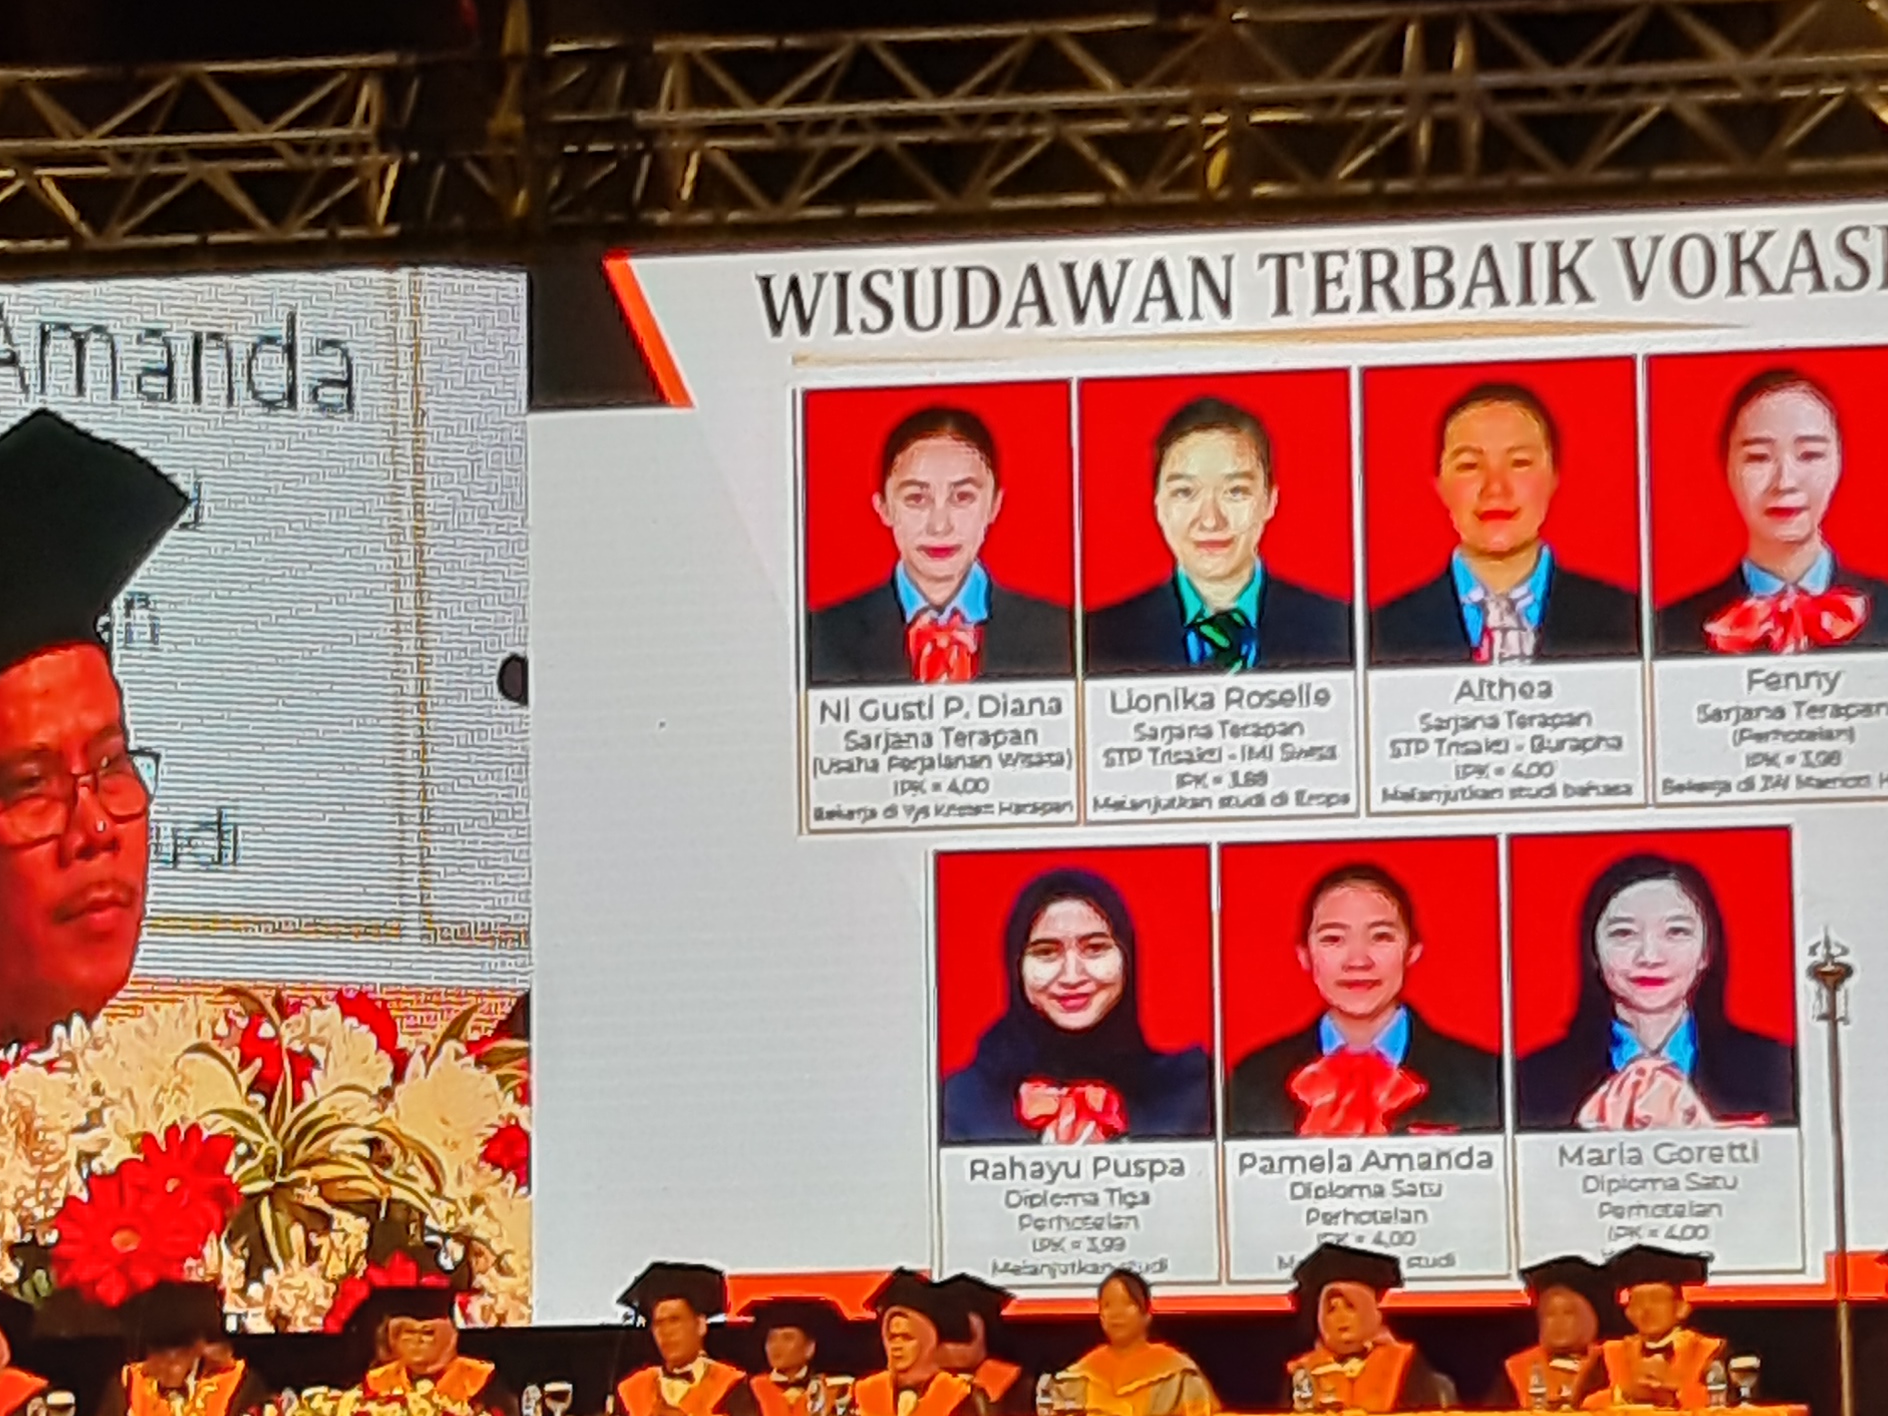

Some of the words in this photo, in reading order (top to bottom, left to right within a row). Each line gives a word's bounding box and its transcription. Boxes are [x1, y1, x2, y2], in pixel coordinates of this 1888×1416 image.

[755, 253, 1235, 338] WISUDAWAN
[1258, 236, 1596, 317] TERBAIK
[1455, 678, 1553, 704] Althea
[1746, 668, 1842, 696] Fenny
[820, 697, 850, 724] Ni
[859, 694, 934, 721] Gusti
[944, 695, 970, 719] P.
[978, 694, 1062, 719] Diana
[1111, 686, 1215, 714] Lionika
[1419, 713, 1499, 734] Sarjana
[1504, 710, 1592, 729] Terapan
[1696, 704, 1786, 725] Sarjana
[844, 730, 933, 753] Sarjana
[940, 727, 1038, 748] Terapan
[1134, 723, 1212, 745] Sarjana
[1219, 720, 1304, 738] Terapan
[1239, 1149, 1352, 1176] Pamela
[1360, 1147, 1493, 1172] Amanda
[1559, 1142, 1643, 1166] Maria
[1654, 1140, 1759, 1165] Goretti
[970, 1156, 1081, 1184] Rahayu
[1093, 1156, 1185, 1181] Puspa
[1005, 1189, 1098, 1208] Diploma
[1104, 1187, 1150, 1208] Tiga
[1290, 1182, 1384, 1202] Diploma
[1392, 1180, 1442, 1198] Satu
[1582, 1175, 1680, 1196] Diploma
[1685, 1173, 1738, 1191] Satu
[1306, 1208, 1428, 1226] Perhotelan
